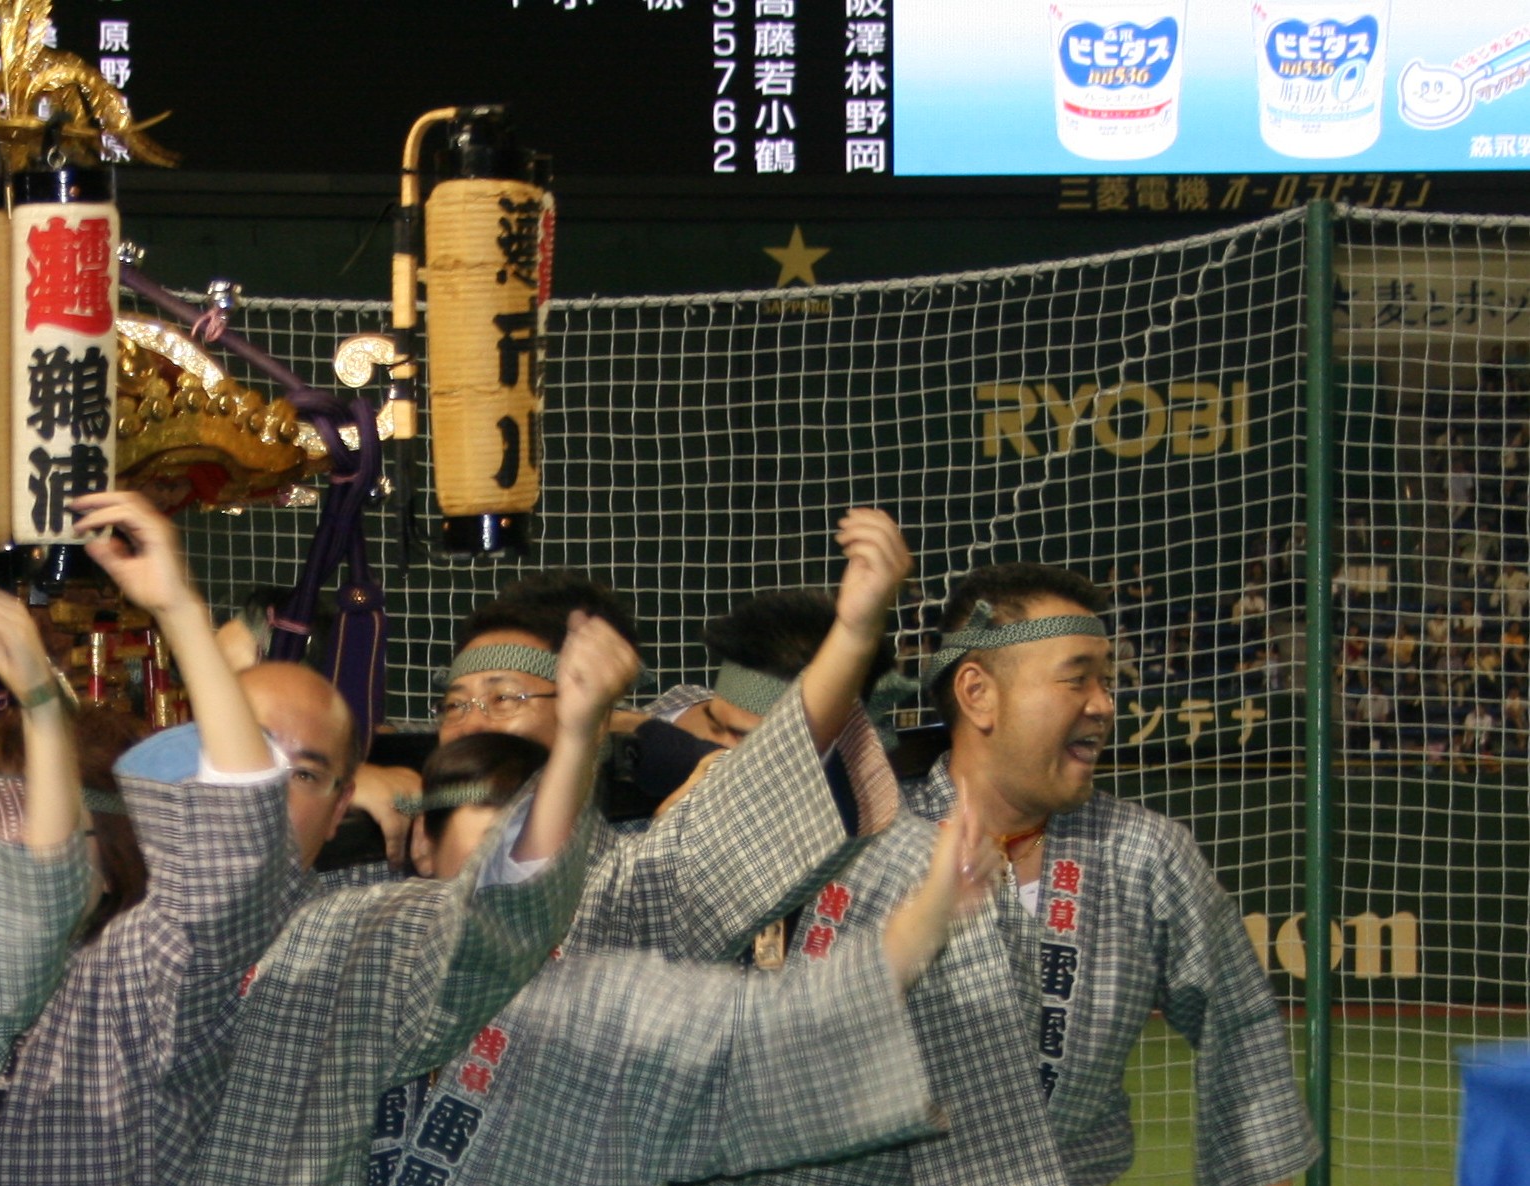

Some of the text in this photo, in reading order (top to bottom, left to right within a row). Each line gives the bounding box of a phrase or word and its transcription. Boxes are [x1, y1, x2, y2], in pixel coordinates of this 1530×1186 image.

[713, 22, 735, 56] 5
[754, 22, 795, 57] 藤
[713, 61, 887, 96] 7 若 林
[713, 100, 887, 135] 6 小 野
[713, 140, 736, 174] 2
[845, 140, 886, 174] 岡
[1058, 174, 1432, 212] 三菱電機 オーロラビジョン
[975, 381, 1249, 458] RYOBI
